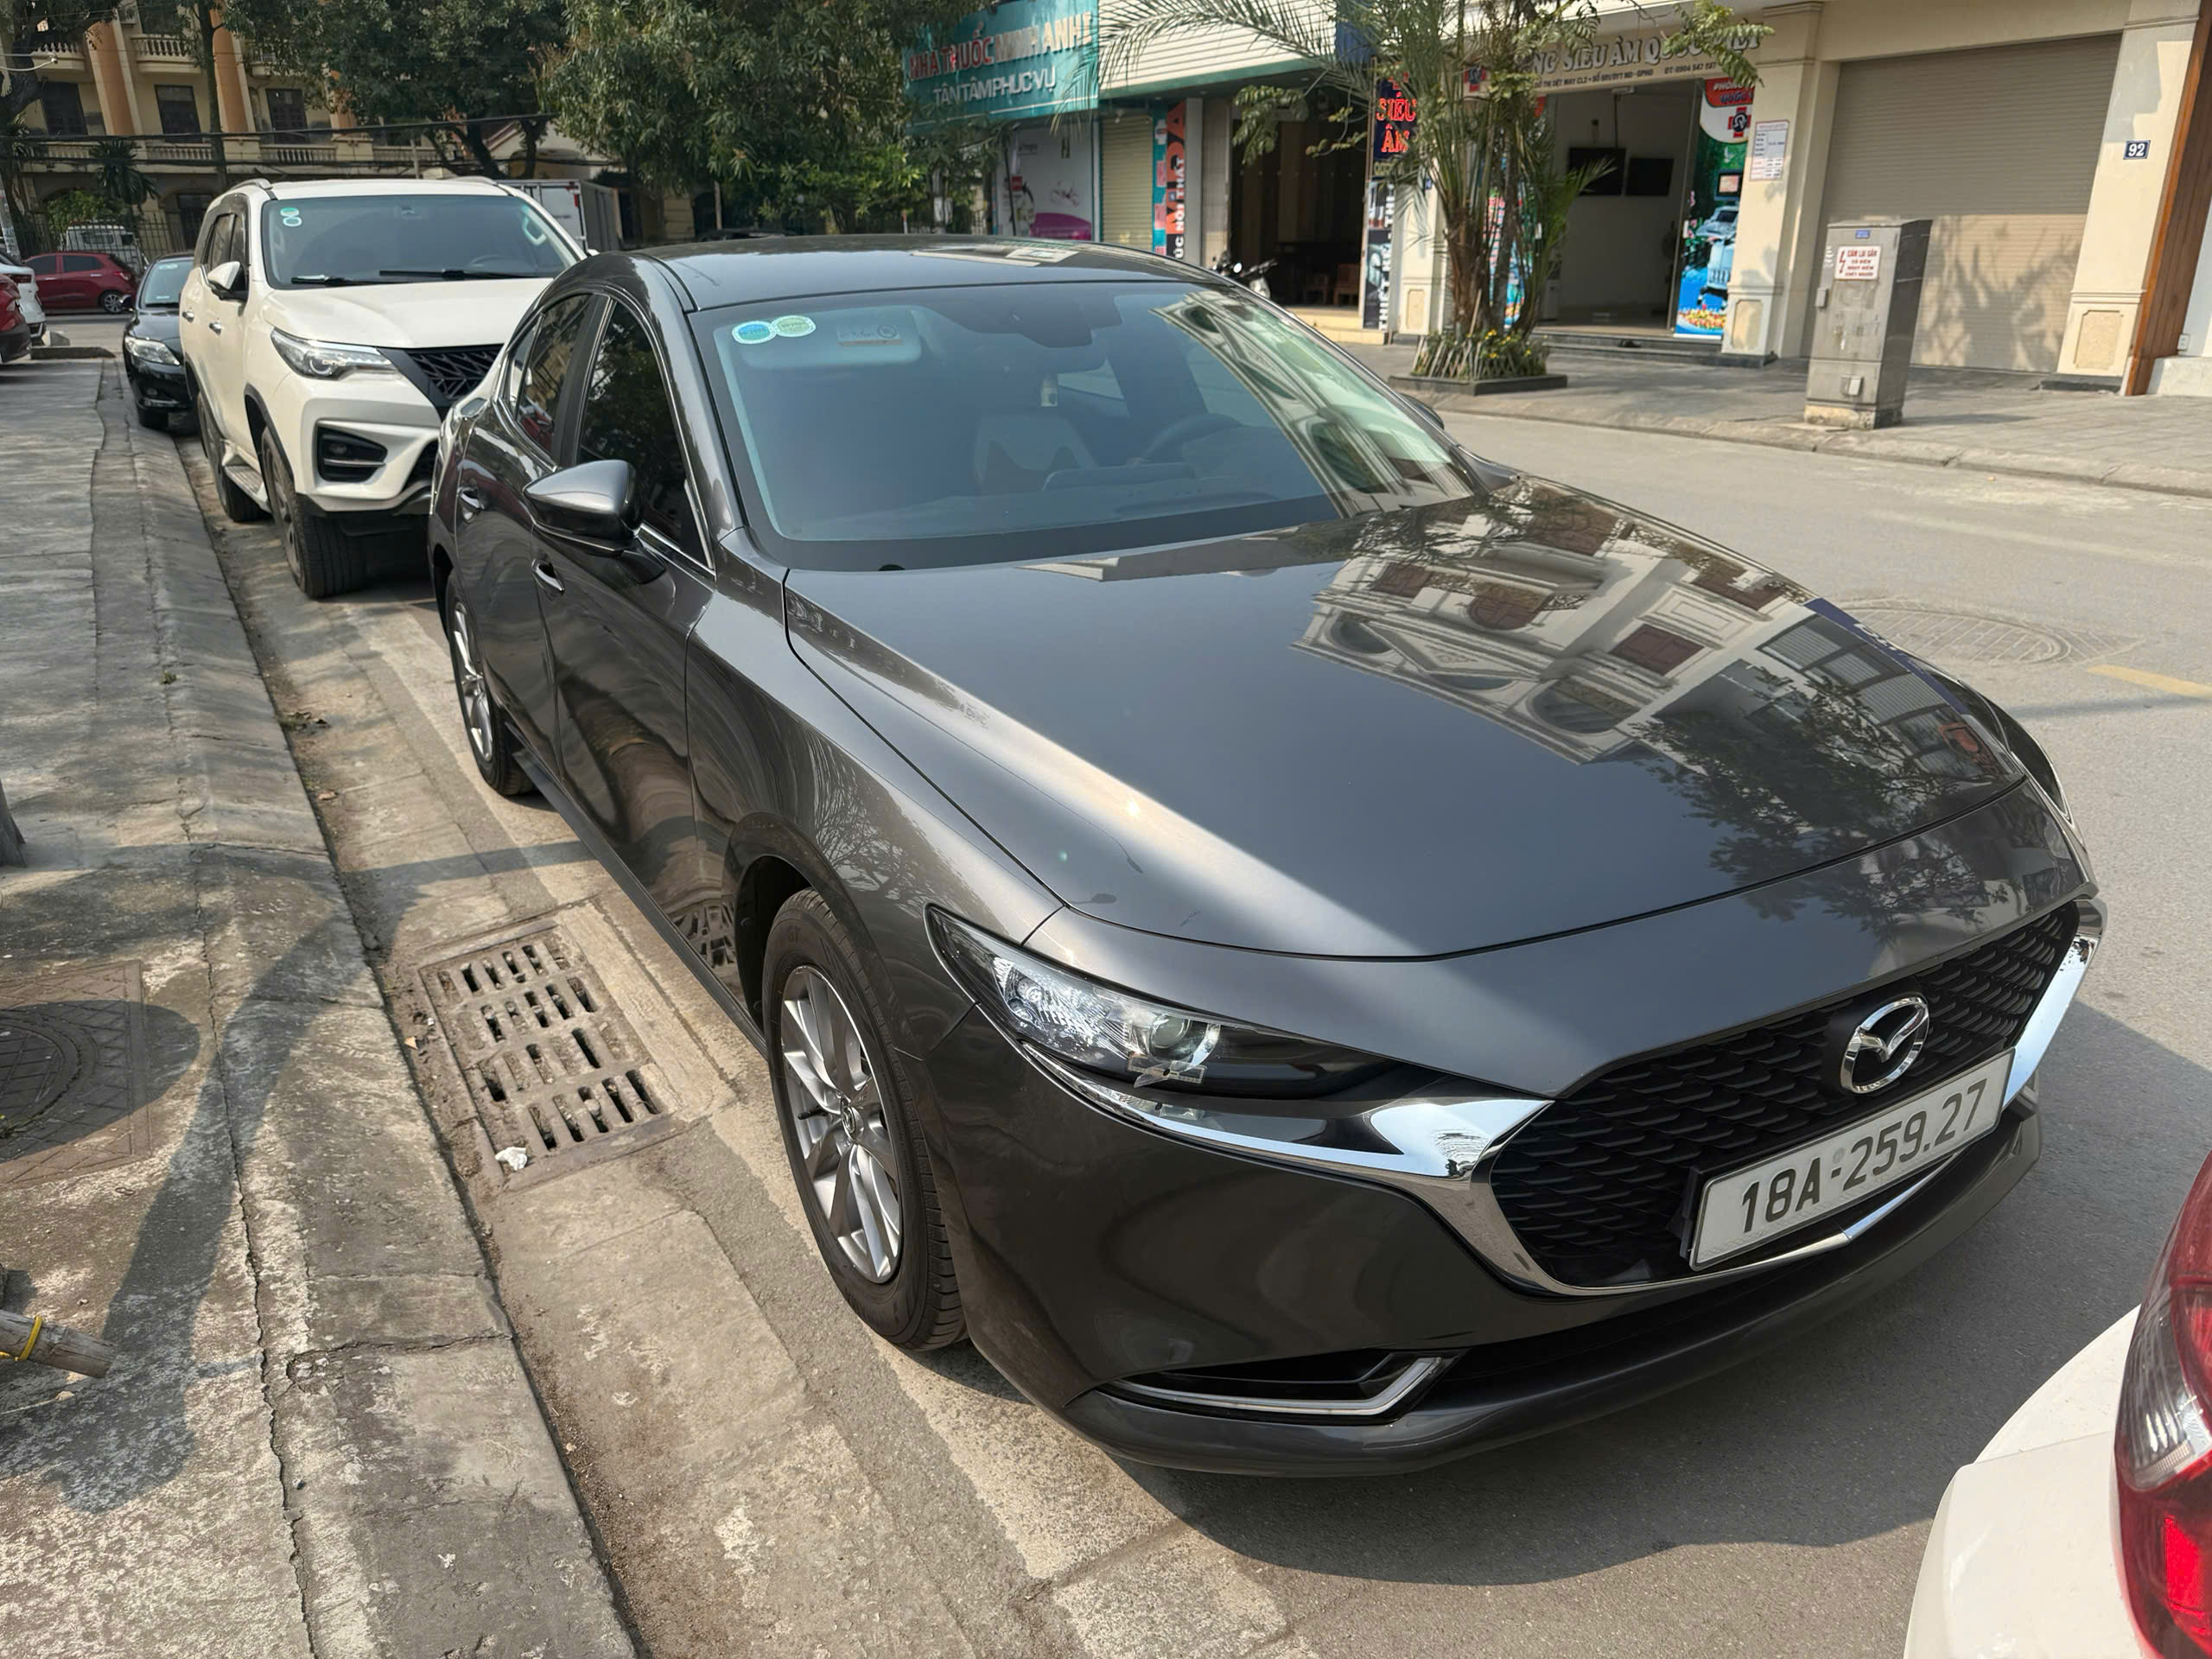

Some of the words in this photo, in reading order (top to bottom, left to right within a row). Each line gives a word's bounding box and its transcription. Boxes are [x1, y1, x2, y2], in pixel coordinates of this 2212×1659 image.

[938, 21, 995, 73] THUỐC
[995, 24, 1039, 63] MINH
[1610, 35, 1643, 67] ÂM
[961, 76, 992, 102] TÂM
[1033, 64, 1056, 92] VỤ
[2128, 143, 2145, 157] 92
[1742, 1077, 1987, 1234] 18A-259.27
